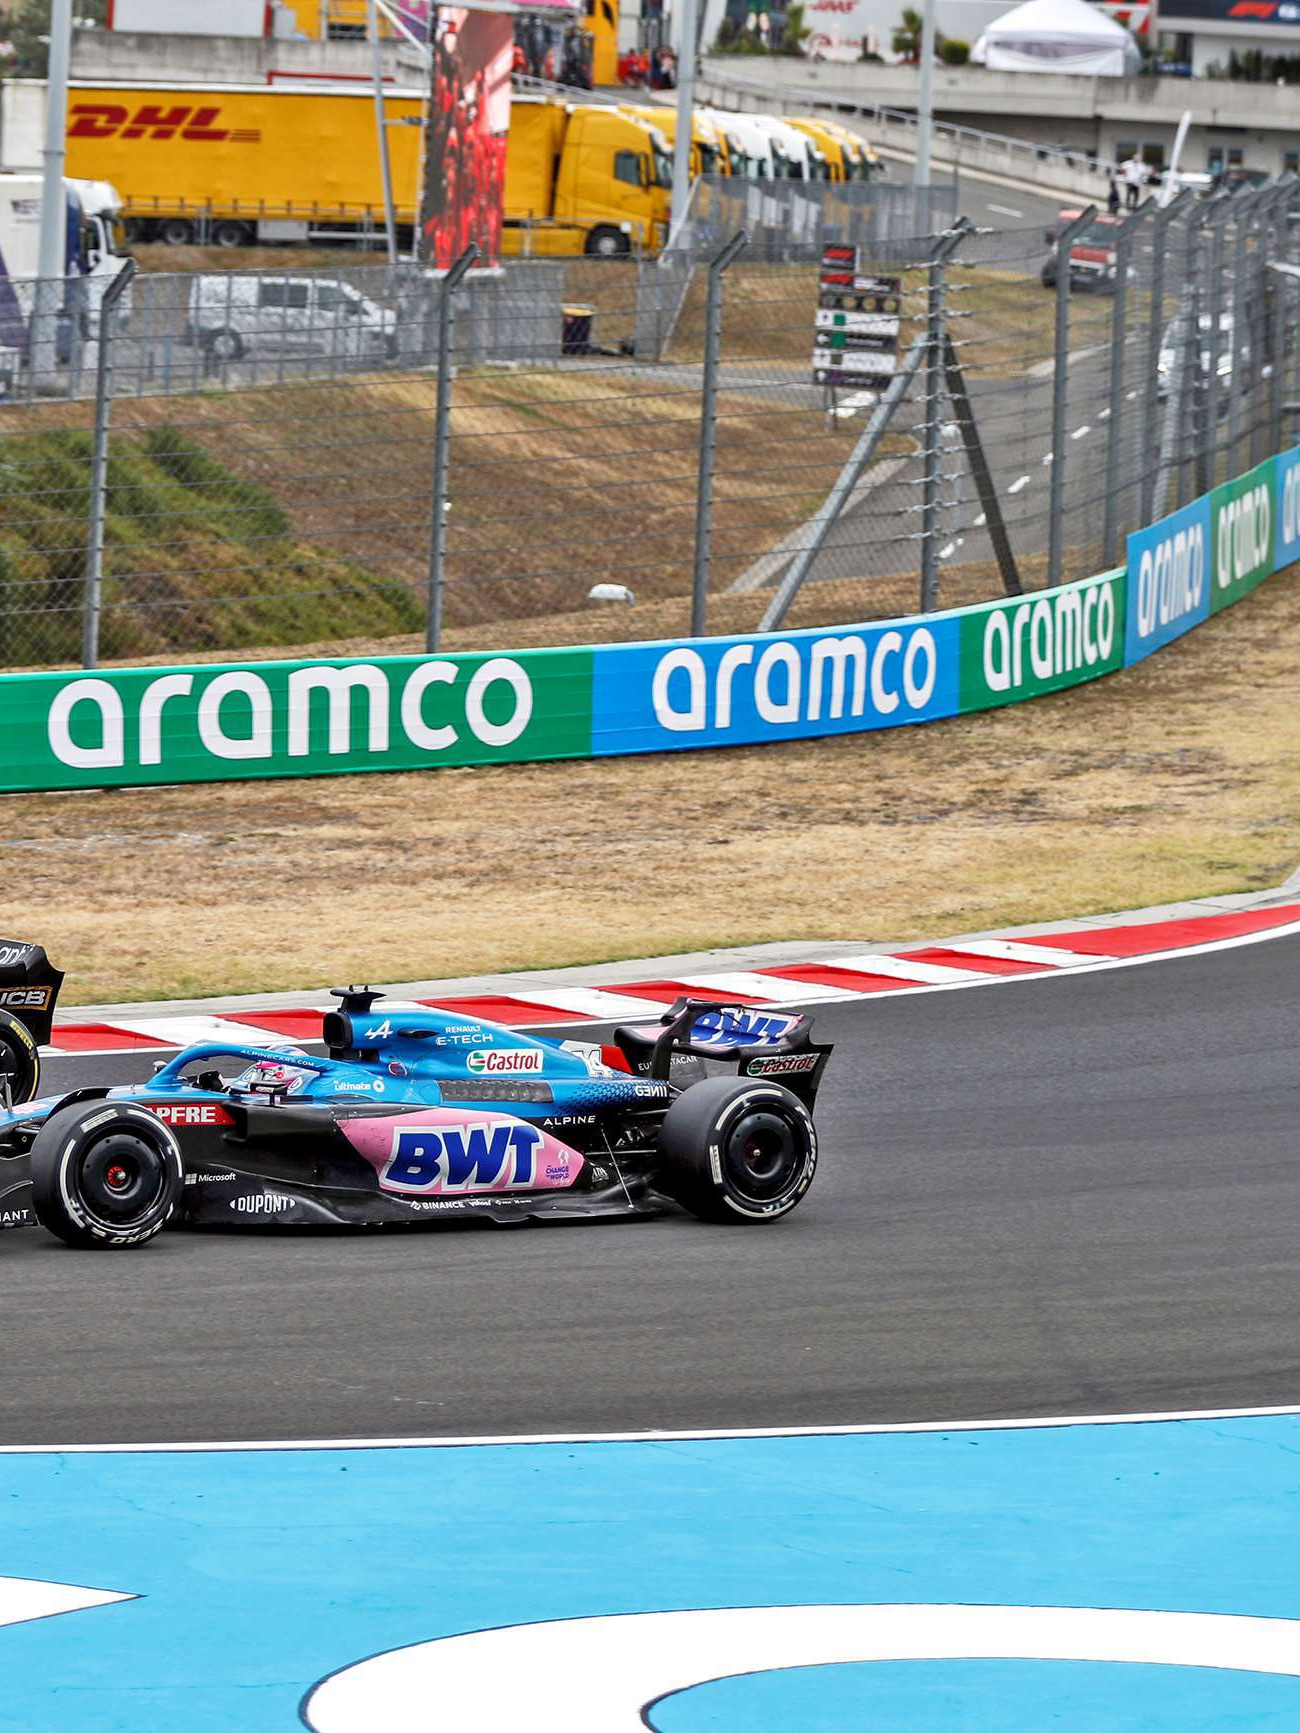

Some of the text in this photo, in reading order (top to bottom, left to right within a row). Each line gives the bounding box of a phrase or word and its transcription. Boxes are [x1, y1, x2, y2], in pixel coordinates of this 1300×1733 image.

[67, 104, 231, 141] DHL
[1218, 484, 1270, 589] aramco
[1137, 523, 1203, 638] aramco
[983, 581, 1115, 692] aramco
[653, 627, 936, 732] aramco
[48, 657, 533, 769] aramco
[445, 1025, 481, 1034] RENAULT
[437, 1033, 493, 1046] E-TECH
[240, 1050, 314, 1067] ALPINECARS.COM
[486, 1052, 539, 1072] Castrol
[763, 1057, 814, 1073] Castrol
[543, 1115, 596, 1126] ALPINE
[382, 1122, 542, 1188] BWT
[198, 1171, 237, 1183] Microsoft
[237, 1195, 288, 1213] DUPONT
[422, 1200, 466, 1210] BINANCE
